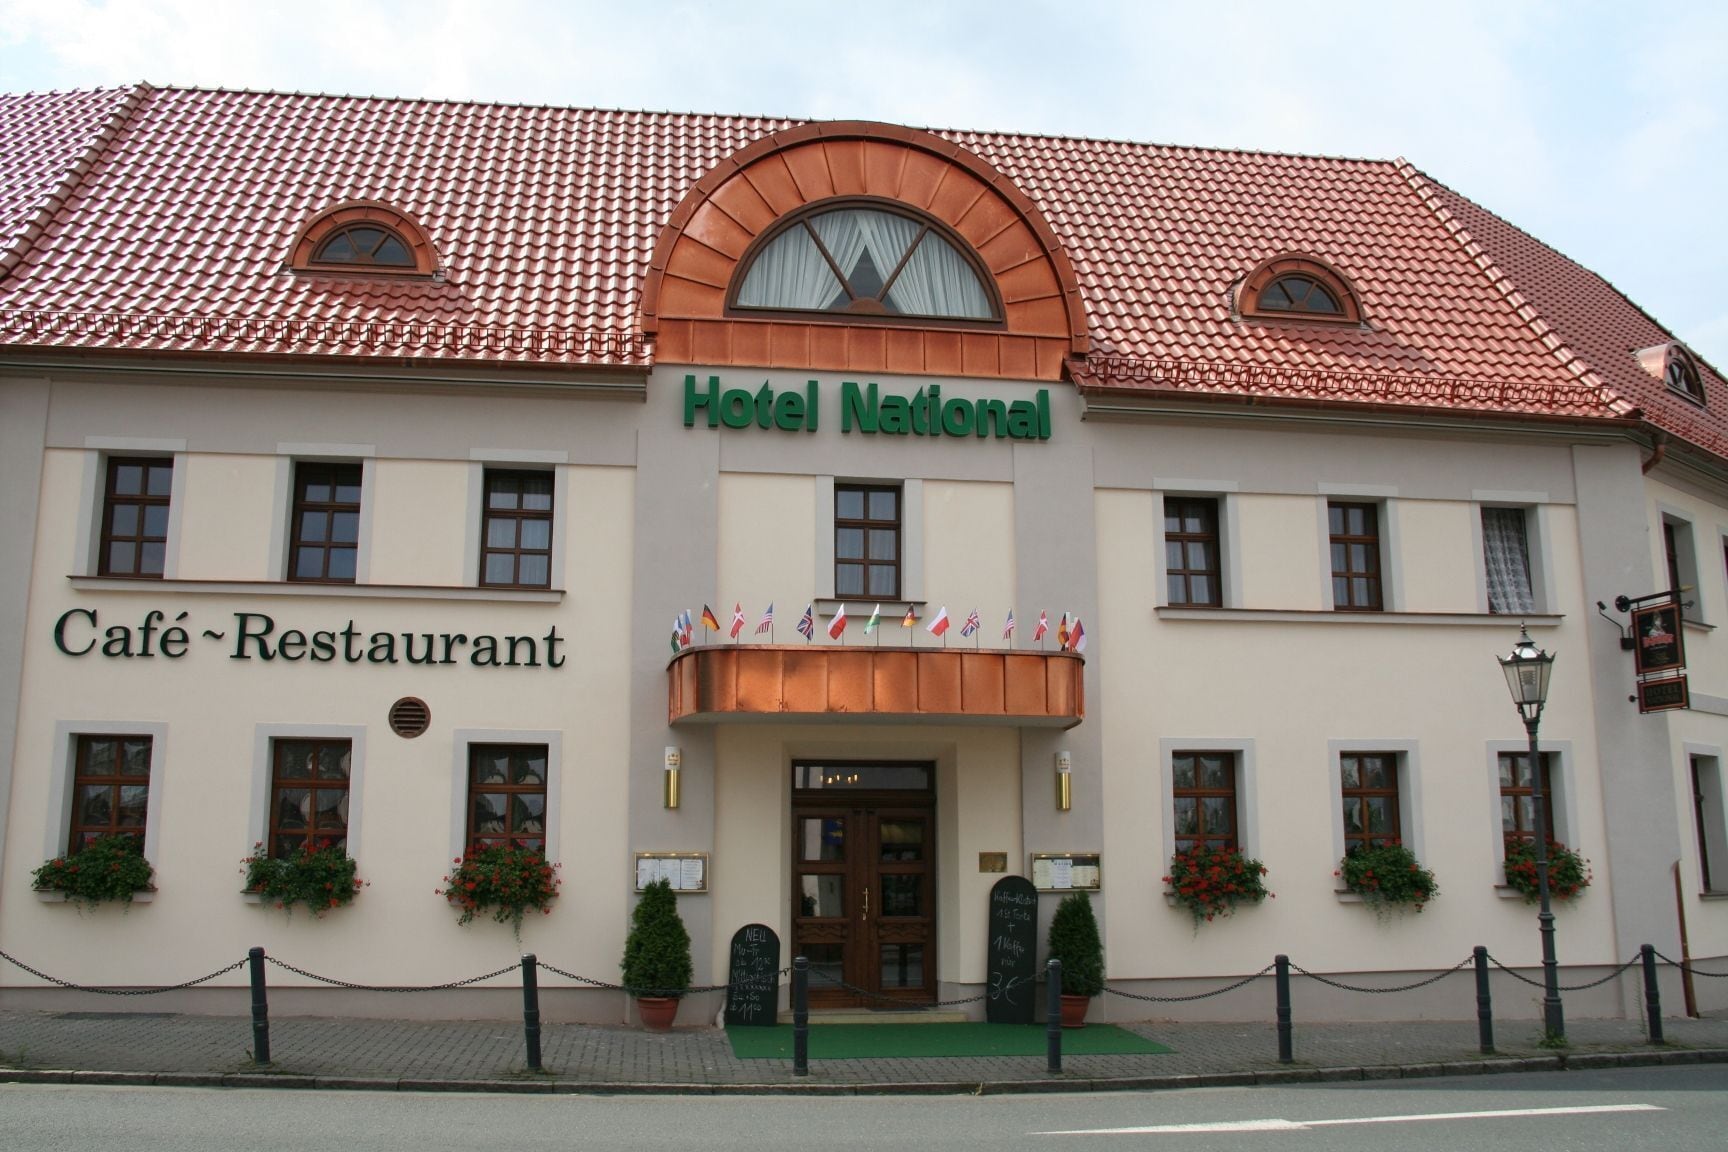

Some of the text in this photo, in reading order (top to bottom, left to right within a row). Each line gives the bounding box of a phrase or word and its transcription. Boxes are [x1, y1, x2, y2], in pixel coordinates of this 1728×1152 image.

[683, 374, 1052, 440] Hotel National
[54, 608, 190, 658] Café
[229, 612, 567, 668] Restaurant
[745, 927, 767, 942] NEU
